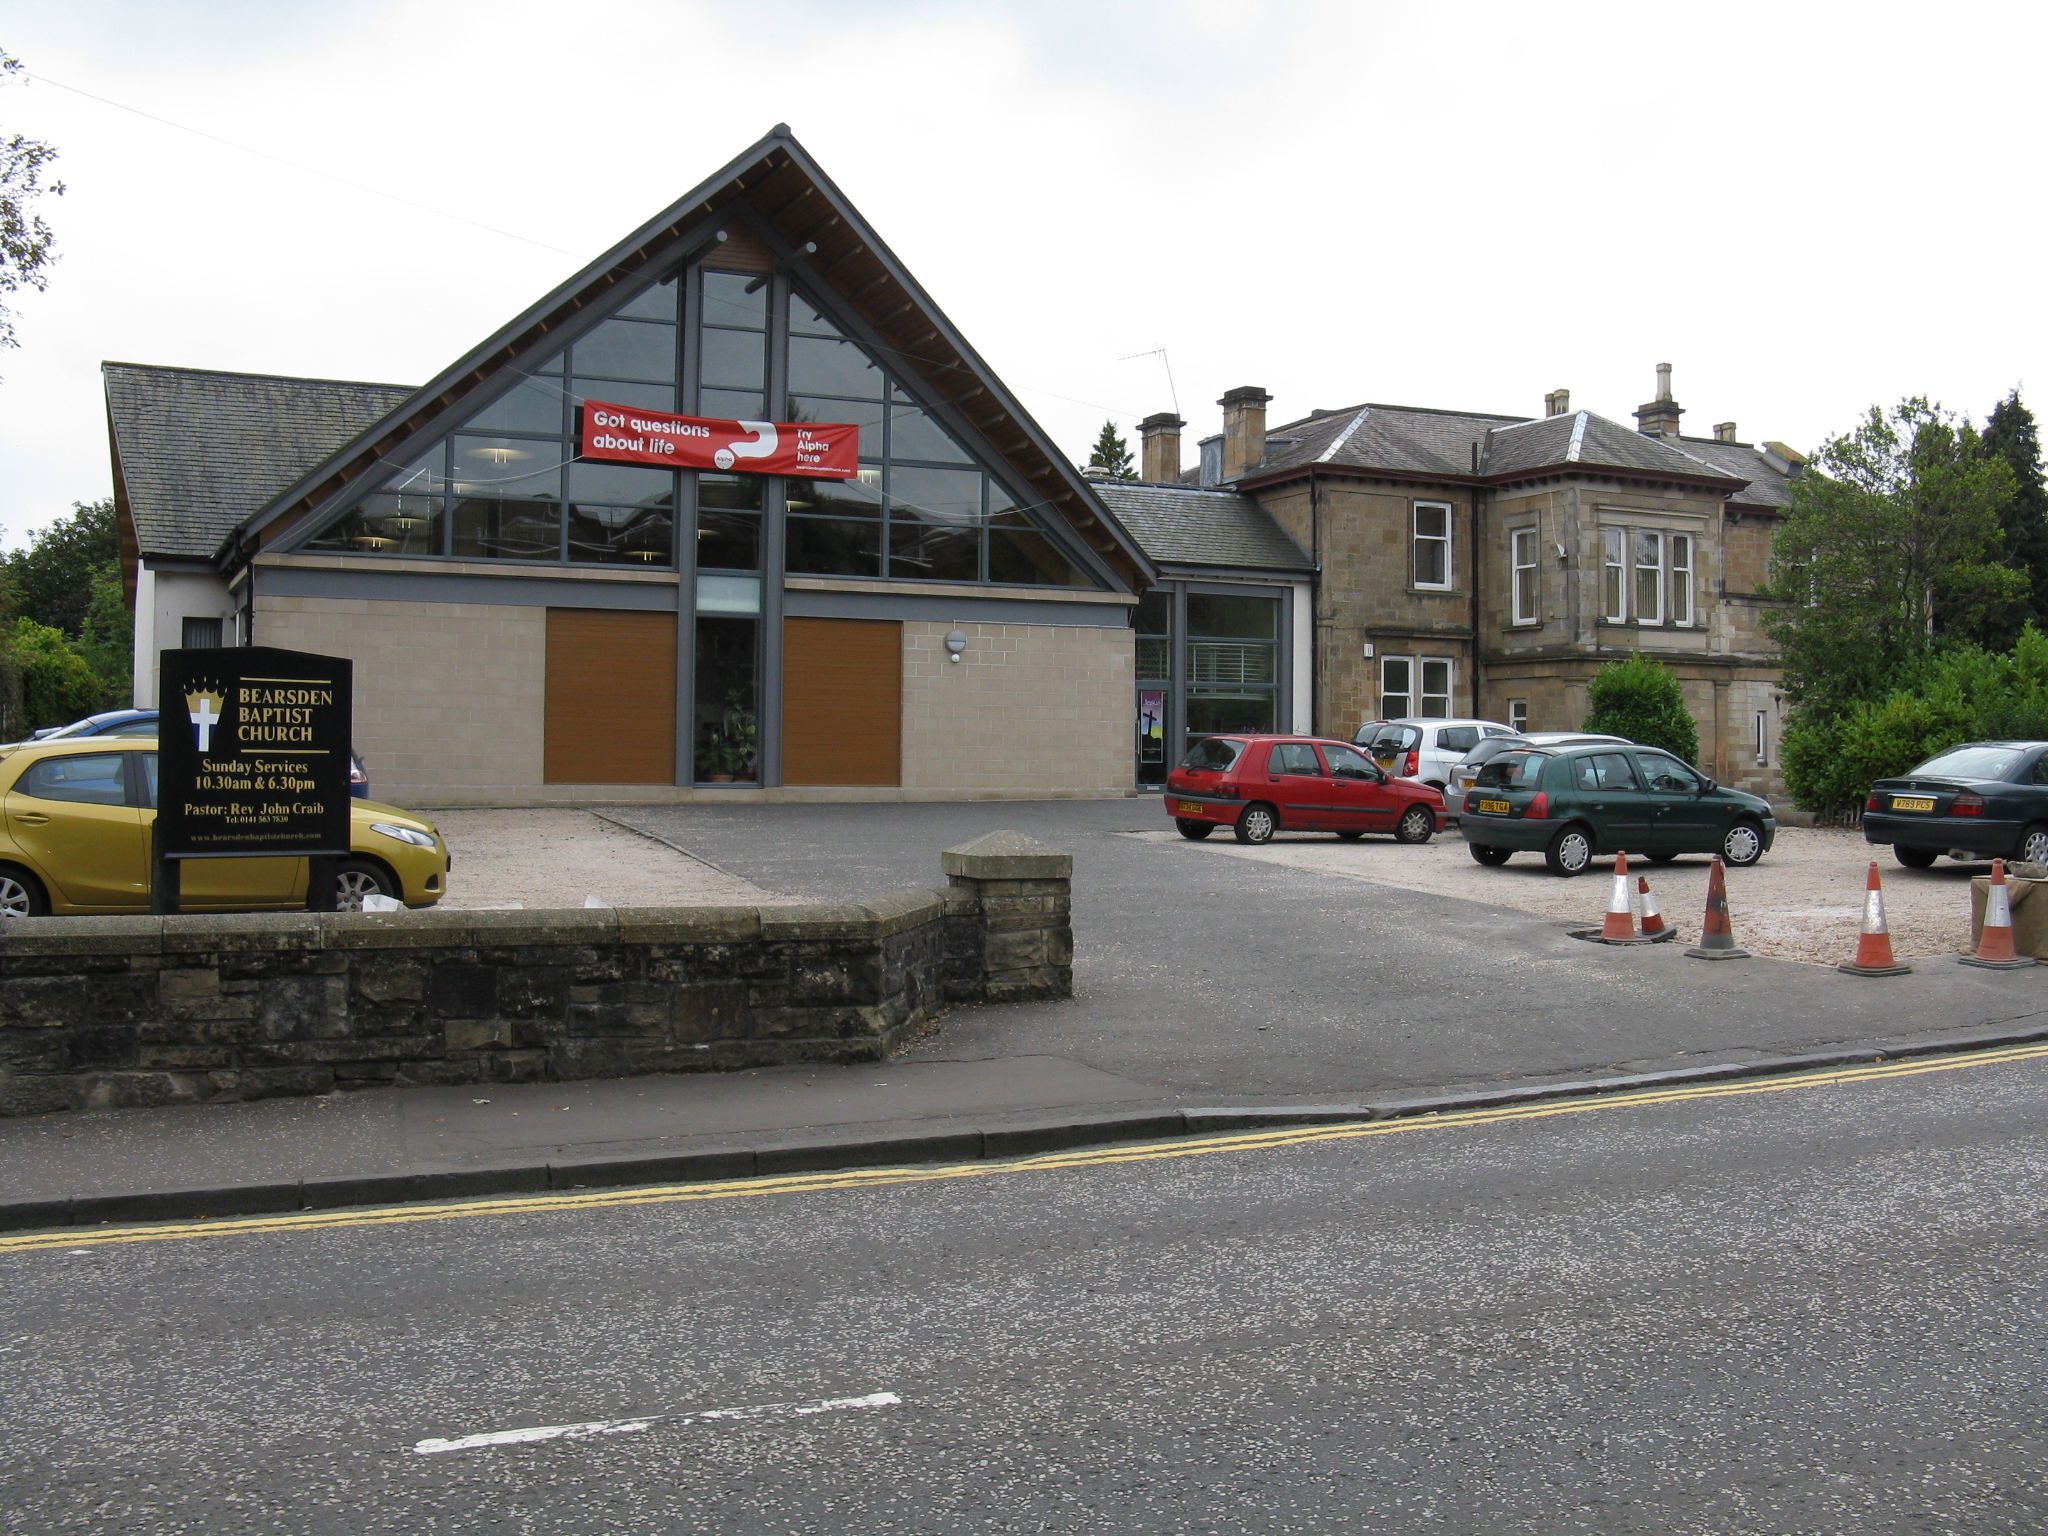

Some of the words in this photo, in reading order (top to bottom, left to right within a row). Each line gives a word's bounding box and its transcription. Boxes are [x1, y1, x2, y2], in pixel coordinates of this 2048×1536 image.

[593, 410, 626, 428] Got
[630, 418, 710, 438] questions
[797, 429, 812, 441] Try
[592, 434, 645, 452] about
[648, 438, 675, 455] life
[797, 440, 829, 452] Alpha
[716, 455, 733, 464] Alpha
[797, 452, 821, 463] here
[238, 688, 333, 706] BEARSDEN
[238, 707, 314, 724] BAPTIST
[237, 725, 313, 742] CHURCH
[202, 759, 251, 775] Sunday
[254, 759, 308, 774] Services
[195, 776, 252, 790] 10.30am
[254, 776, 265, 790] &
[268, 776, 316, 793] 6.30pm
[184, 803, 228, 816] Pastor:
[230, 803, 255, 815] Rev
[260, 802, 290, 815] John
[292, 802, 324, 814] Craib
[1896, 799, 1915, 808] V789
[1915, 801, 1931, 809] PCS
[225, 816, 240, 824] Tel:
[240, 816, 257, 824] 0141
